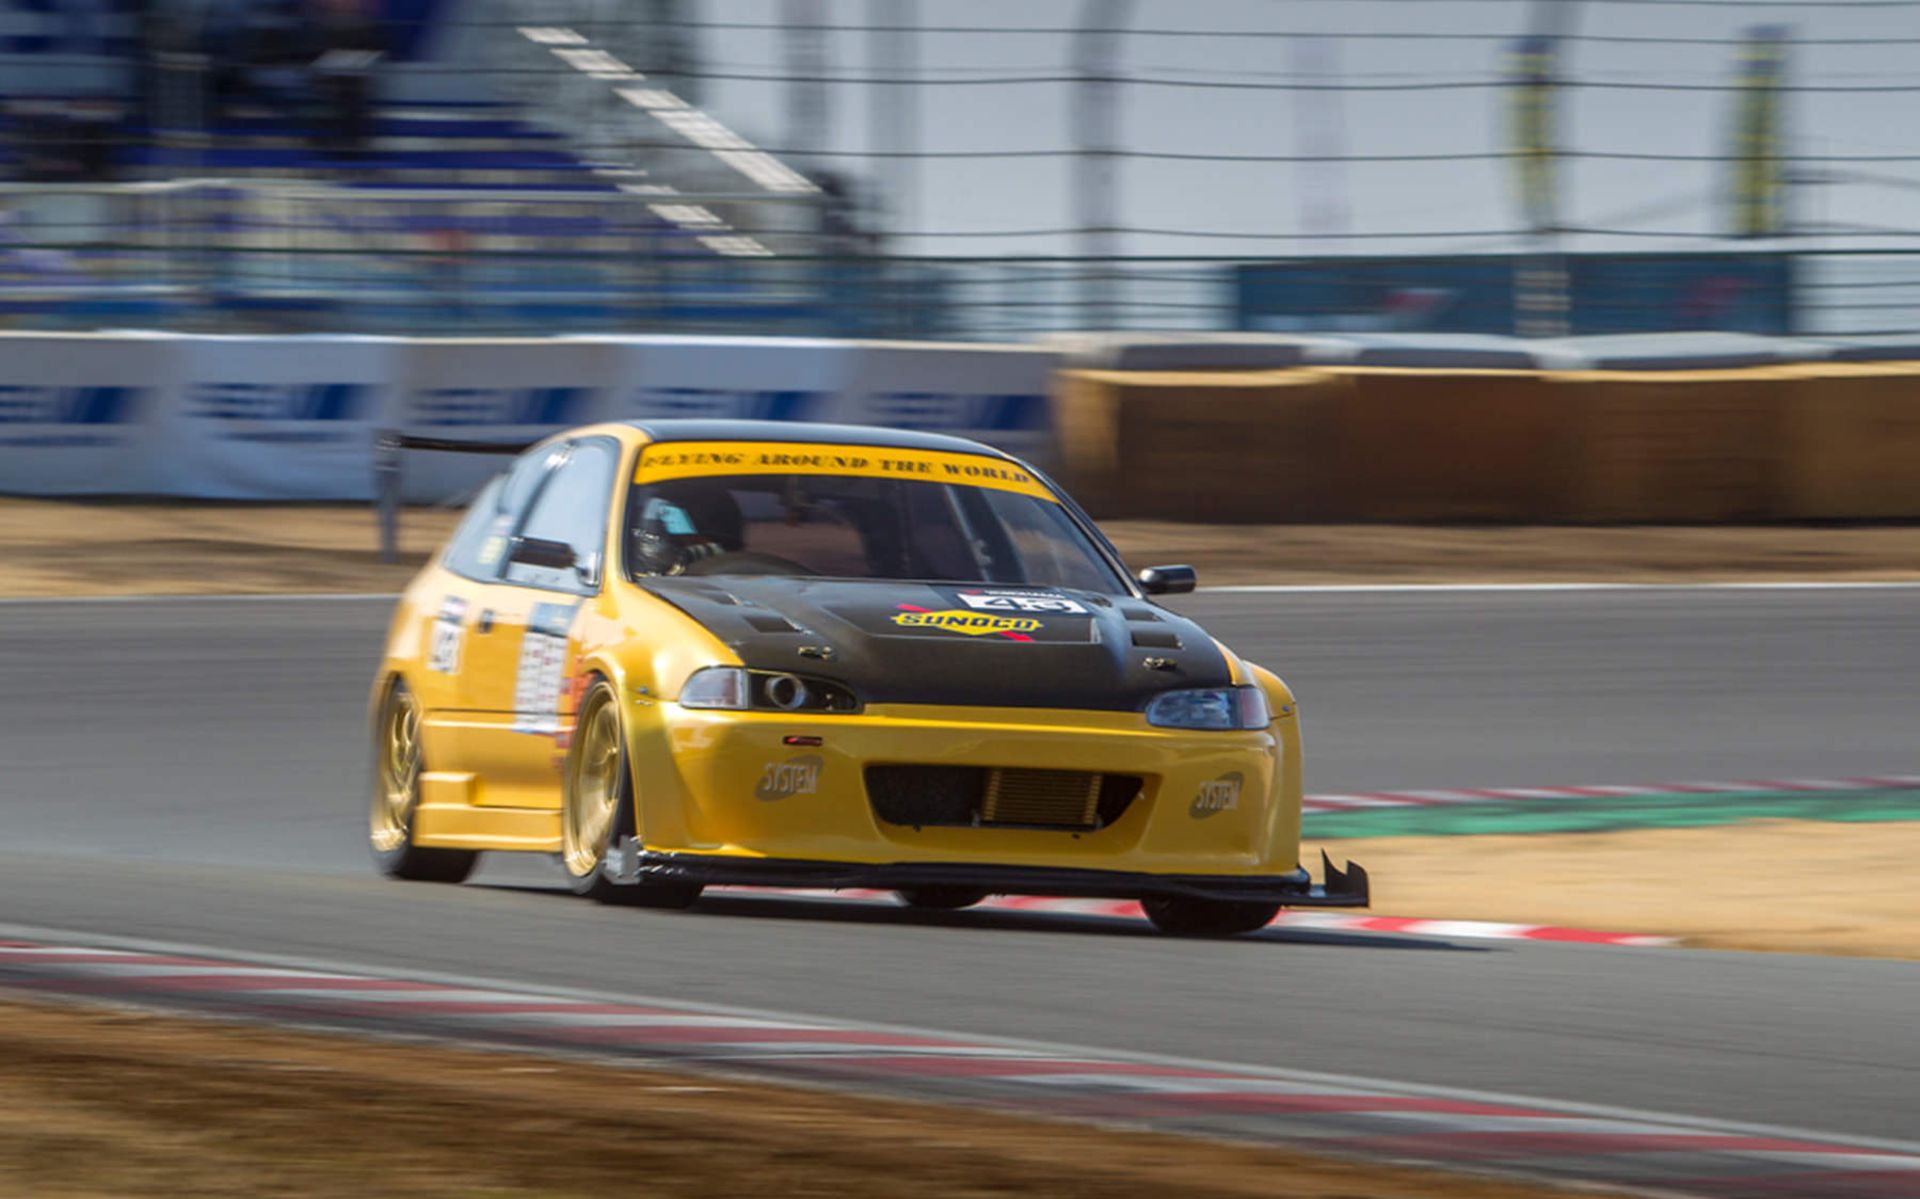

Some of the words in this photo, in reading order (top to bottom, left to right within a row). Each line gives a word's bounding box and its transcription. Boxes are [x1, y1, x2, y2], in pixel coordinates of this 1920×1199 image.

[754, 453, 869, 469] AROUND
[879, 459, 932, 473] THE
[942, 463, 1030, 483] WORLD
[901, 614, 1035, 630] SUNOCO
[763, 762, 818, 794] SYSTEM
[1196, 780, 1240, 811] SYSTEM
